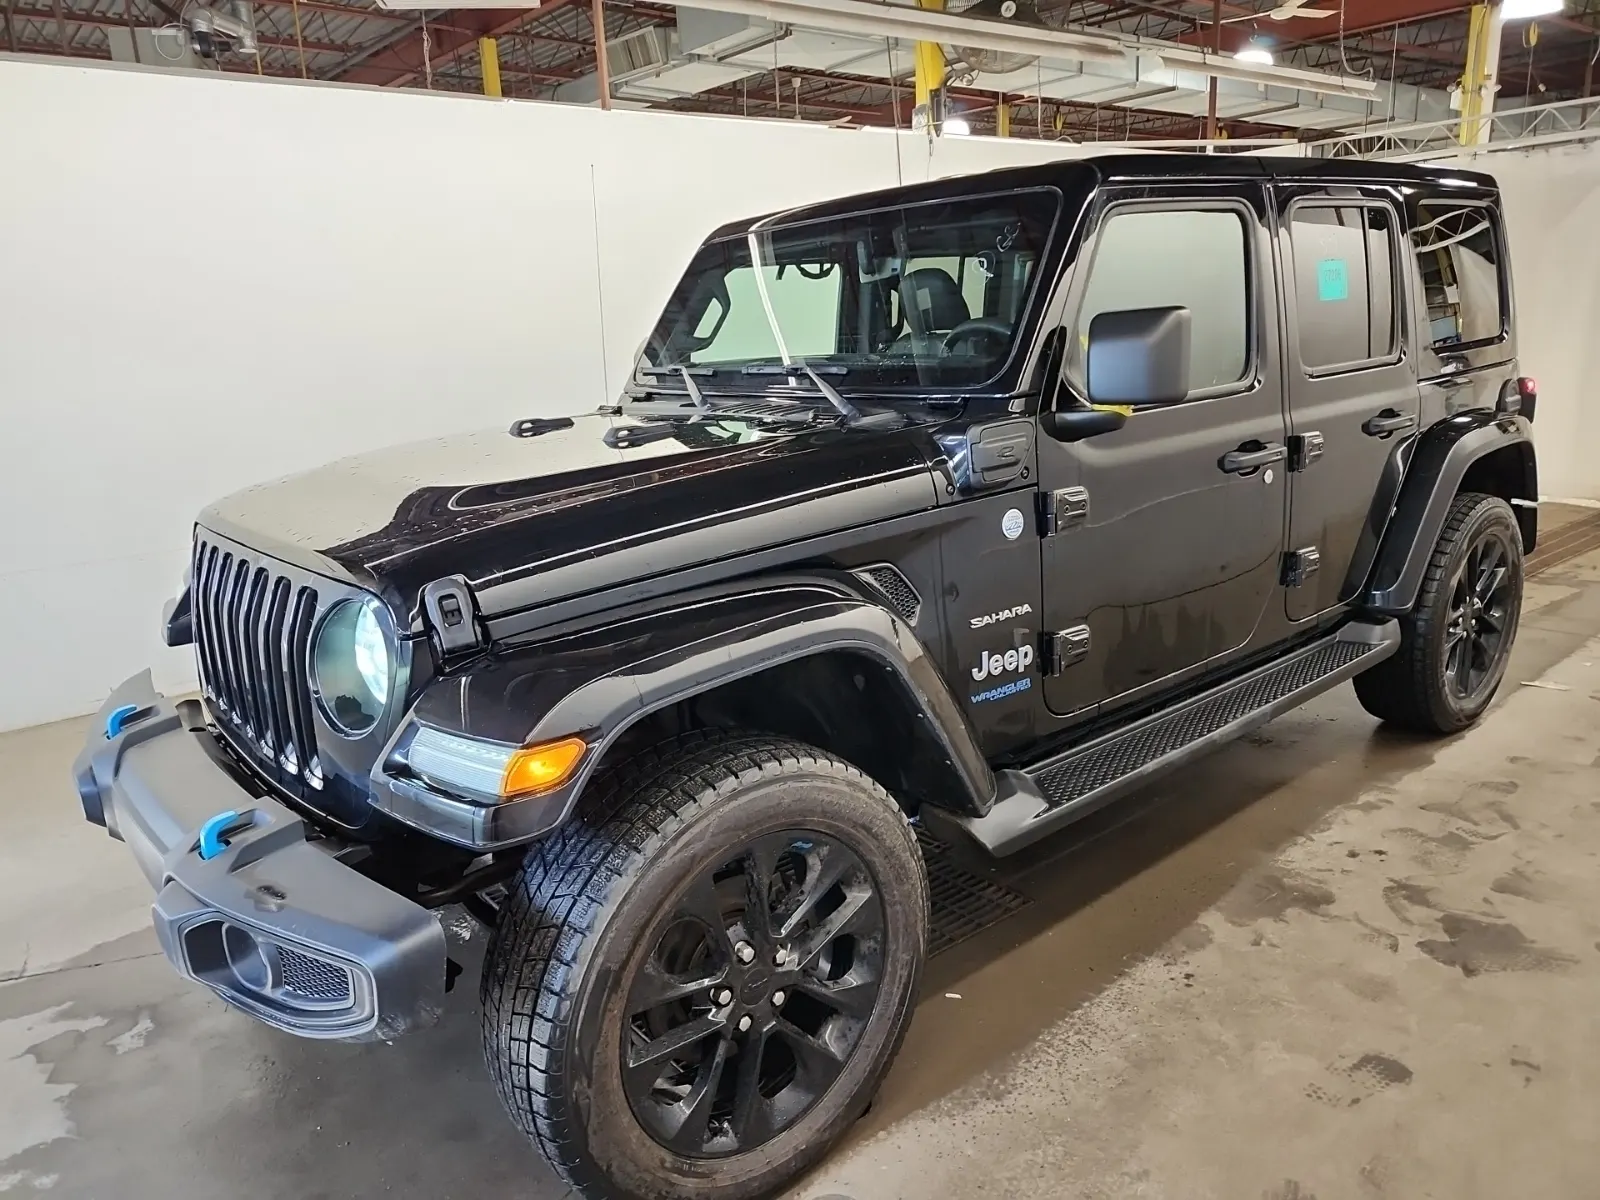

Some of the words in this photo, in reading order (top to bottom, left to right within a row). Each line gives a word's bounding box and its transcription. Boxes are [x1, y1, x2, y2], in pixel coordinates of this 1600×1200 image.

[970, 603, 1032, 629] SAHARA
[971, 644, 1034, 681] Jeep
[971, 678, 1031, 703] WRANGLER
